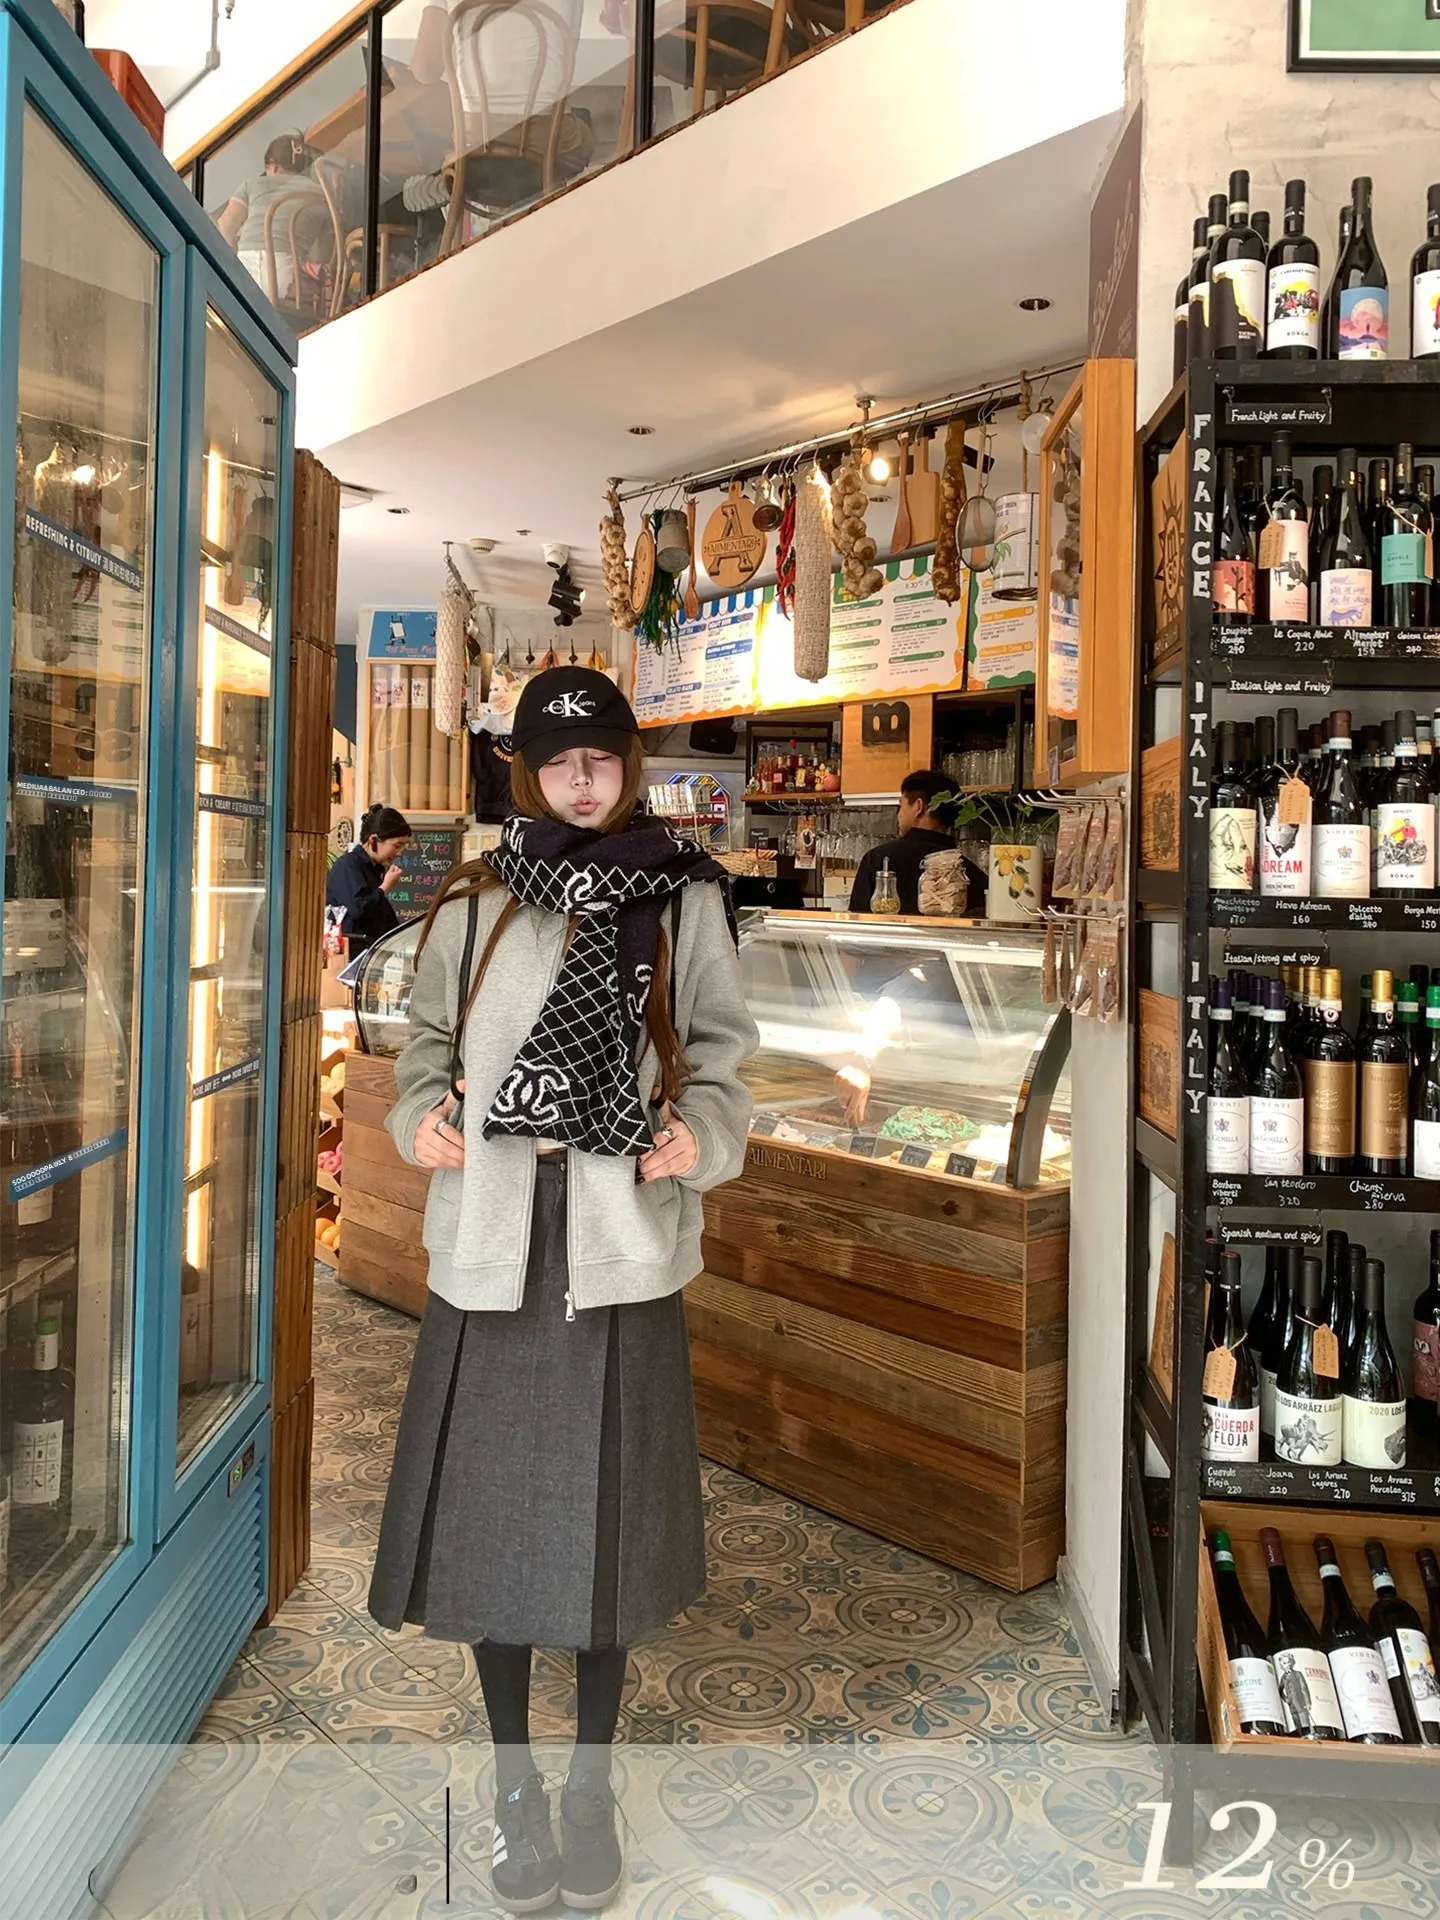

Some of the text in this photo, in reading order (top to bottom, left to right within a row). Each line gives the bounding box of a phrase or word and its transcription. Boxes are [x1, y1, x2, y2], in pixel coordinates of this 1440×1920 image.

[1281, 409, 1296, 421] and
[1299, 409, 1326, 424] Fruity
[25, 513, 69, 549] REFRESHING
[1294, 641, 1315, 653] 220
[1229, 680, 1263, 691] Italian
[1284, 680, 1300, 691] and
[1304, 680, 1331, 695] Fruity
[1349, 904, 1383, 913] Dolcetto
[1292, 915, 1311, 925] 160
[1421, 920, 1437, 929] 150
[1282, 952, 1297, 962] and
[1300, 953, 1320, 966] spicy
[1278, 1195, 1300, 1207] 320
[1364, 1199, 1384, 1210] 280
[1221, 1226, 1252, 1242] Spanish
[1283, 1230, 1298, 1240] and
[1300, 1230, 1321, 1245] spicy
[1369, 1405, 1390, 1416] 2020
[1214, 1419, 1255, 1433] CUERDA
[1214, 1430, 1249, 1447] FLOJA
[1308, 1470, 1320, 1479] Los
[1370, 1474, 1383, 1483] Los
[1227, 1486, 1242, 1494] 220
[1269, 1486, 1288, 1495] 220
[1333, 1488, 1351, 1499] 270
